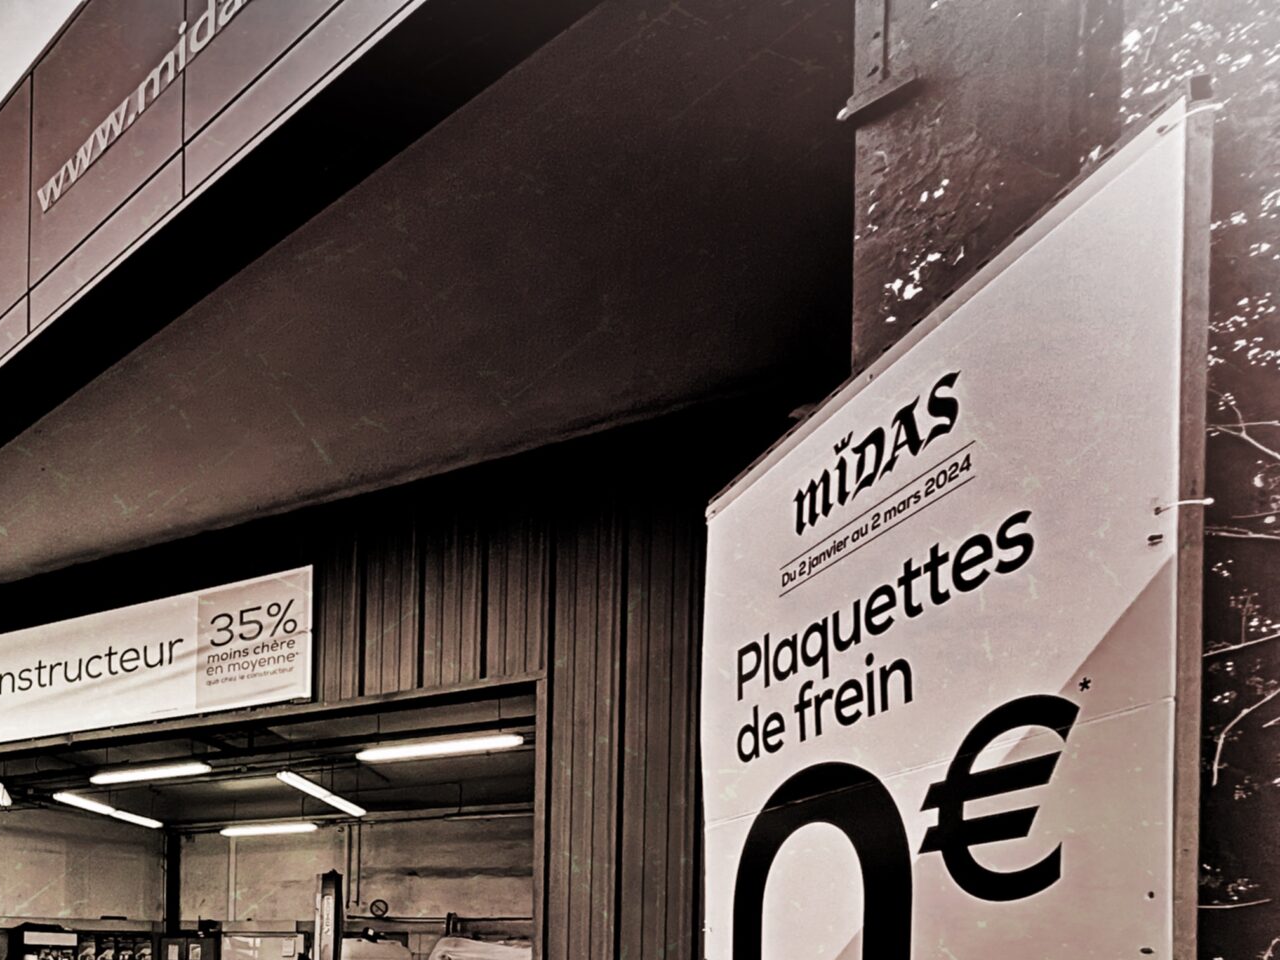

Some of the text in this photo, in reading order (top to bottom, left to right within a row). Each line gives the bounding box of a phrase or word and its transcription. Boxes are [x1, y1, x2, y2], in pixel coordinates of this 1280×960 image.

[781, 453, 973, 588] Du 2 janvier au 2 mars 2024
[210, 598, 298, 647] 35%
[736, 509, 1035, 702] Plaquettes
[206, 664, 224, 676] en
[207, 639, 296, 665] moins chère
[736, 652, 913, 763] de frein
